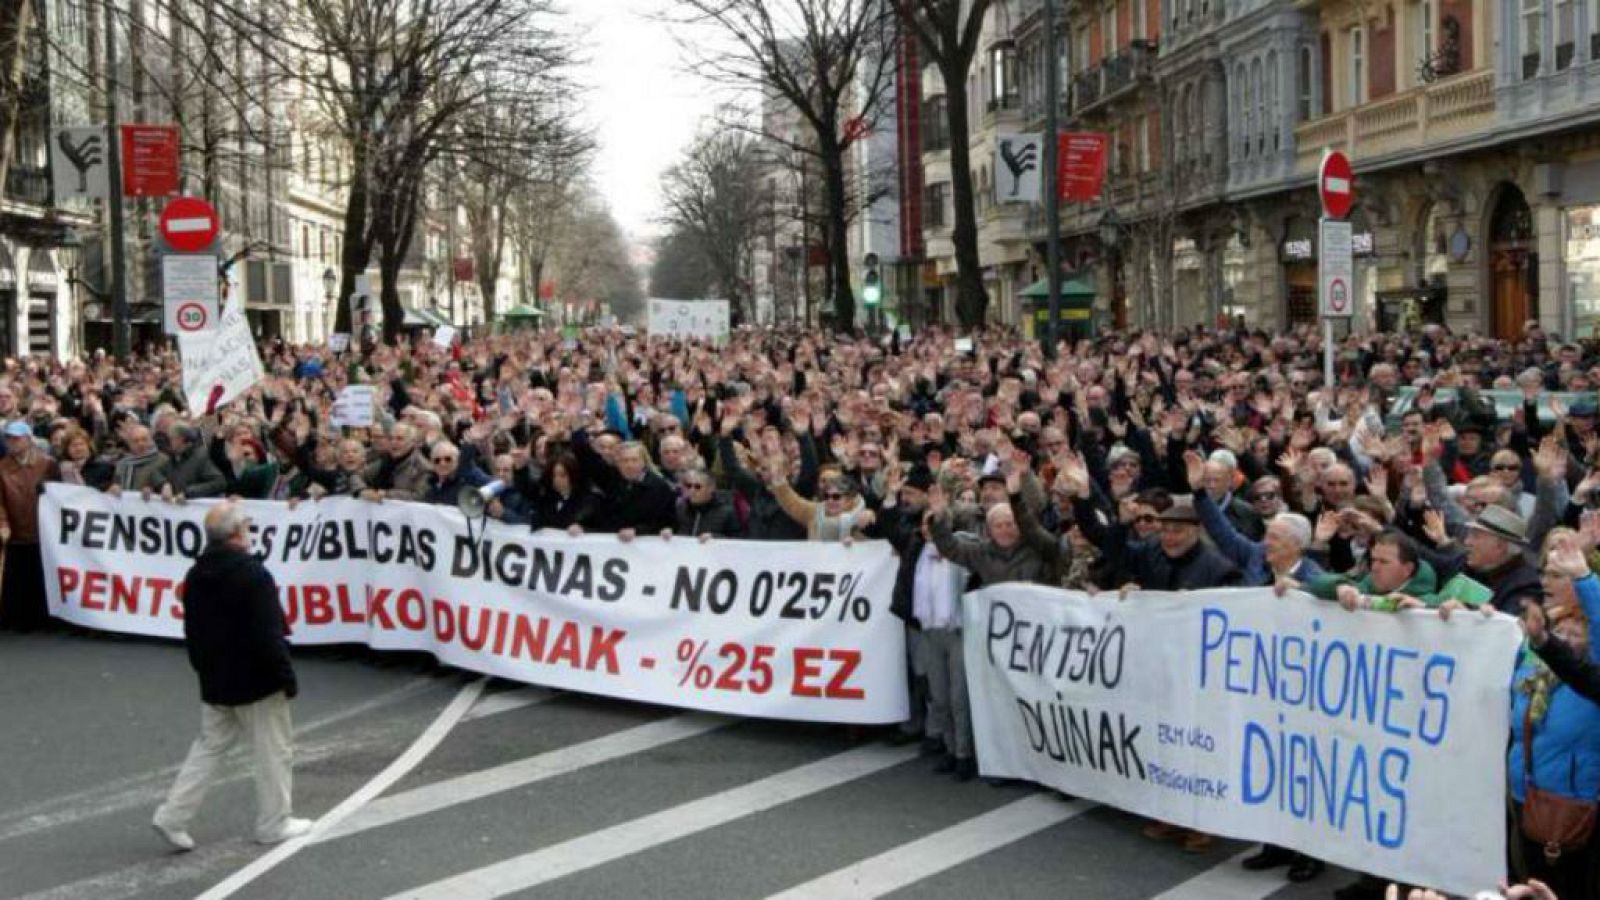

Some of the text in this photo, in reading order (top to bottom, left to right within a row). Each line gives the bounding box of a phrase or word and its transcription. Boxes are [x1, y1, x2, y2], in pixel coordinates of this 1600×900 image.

[282, 513, 437, 572] PÚBLICAS
[451, 534, 629, 603] DIGNAS
[670, 565, 738, 615] NO
[749, 569, 871, 623] 0'25%
[432, 597, 627, 676] DUINAK
[676, 637, 775, 694] %25
[791, 648, 866, 700] EZ
